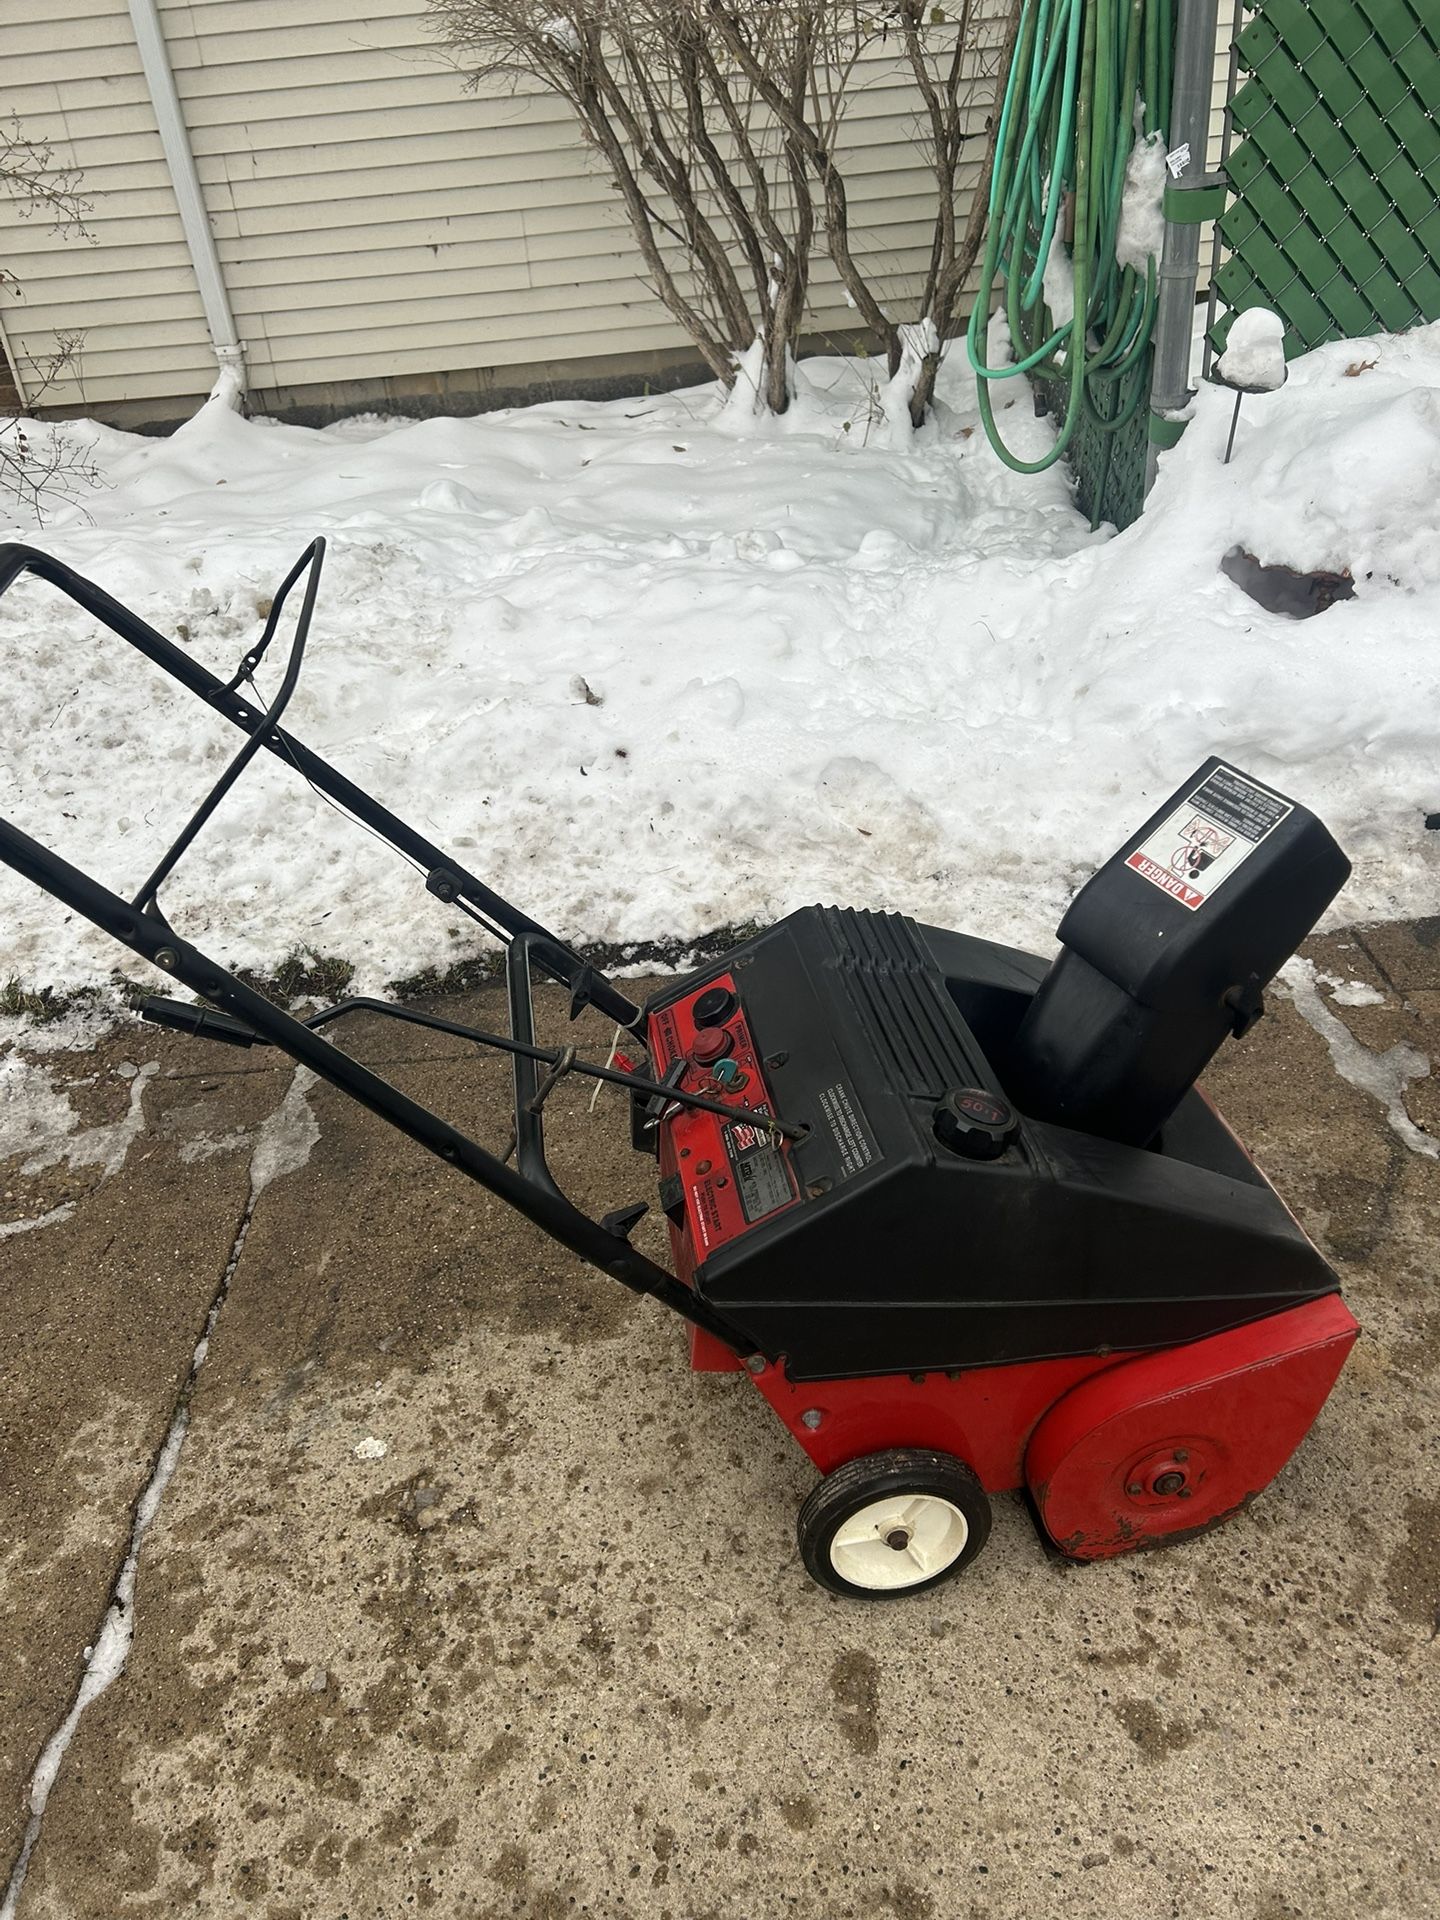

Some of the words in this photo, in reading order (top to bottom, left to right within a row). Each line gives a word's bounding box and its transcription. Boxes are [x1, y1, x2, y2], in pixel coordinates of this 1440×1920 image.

[1137, 859, 1184, 895] DANGER
[735, 1024, 748, 1049] PRIMER
[817, 1092, 834, 1121] CLOCKWISE
[826, 1087, 840, 1110] CLOCKWISE
[837, 1114, 852, 1138] DISCHARGE
[846, 1136, 856, 1149] LEFT
[851, 1146, 864, 1168] COUNTER
[828, 1119, 837, 1127] TO
[834, 1083, 846, 1099] CRANK
[840, 1098, 852, 1114] CHUTE
[847, 1113, 863, 1140] DIRECTION
[858, 1138, 873, 1163] CONTROL
[831, 1126, 849, 1157] DISCHARGE
[743, 1161, 753, 1176] MTD
[843, 1155, 856, 1174] RIGHT
[703, 1178, 717, 1210] ELECTRIC
[711, 1209, 722, 1232] START
